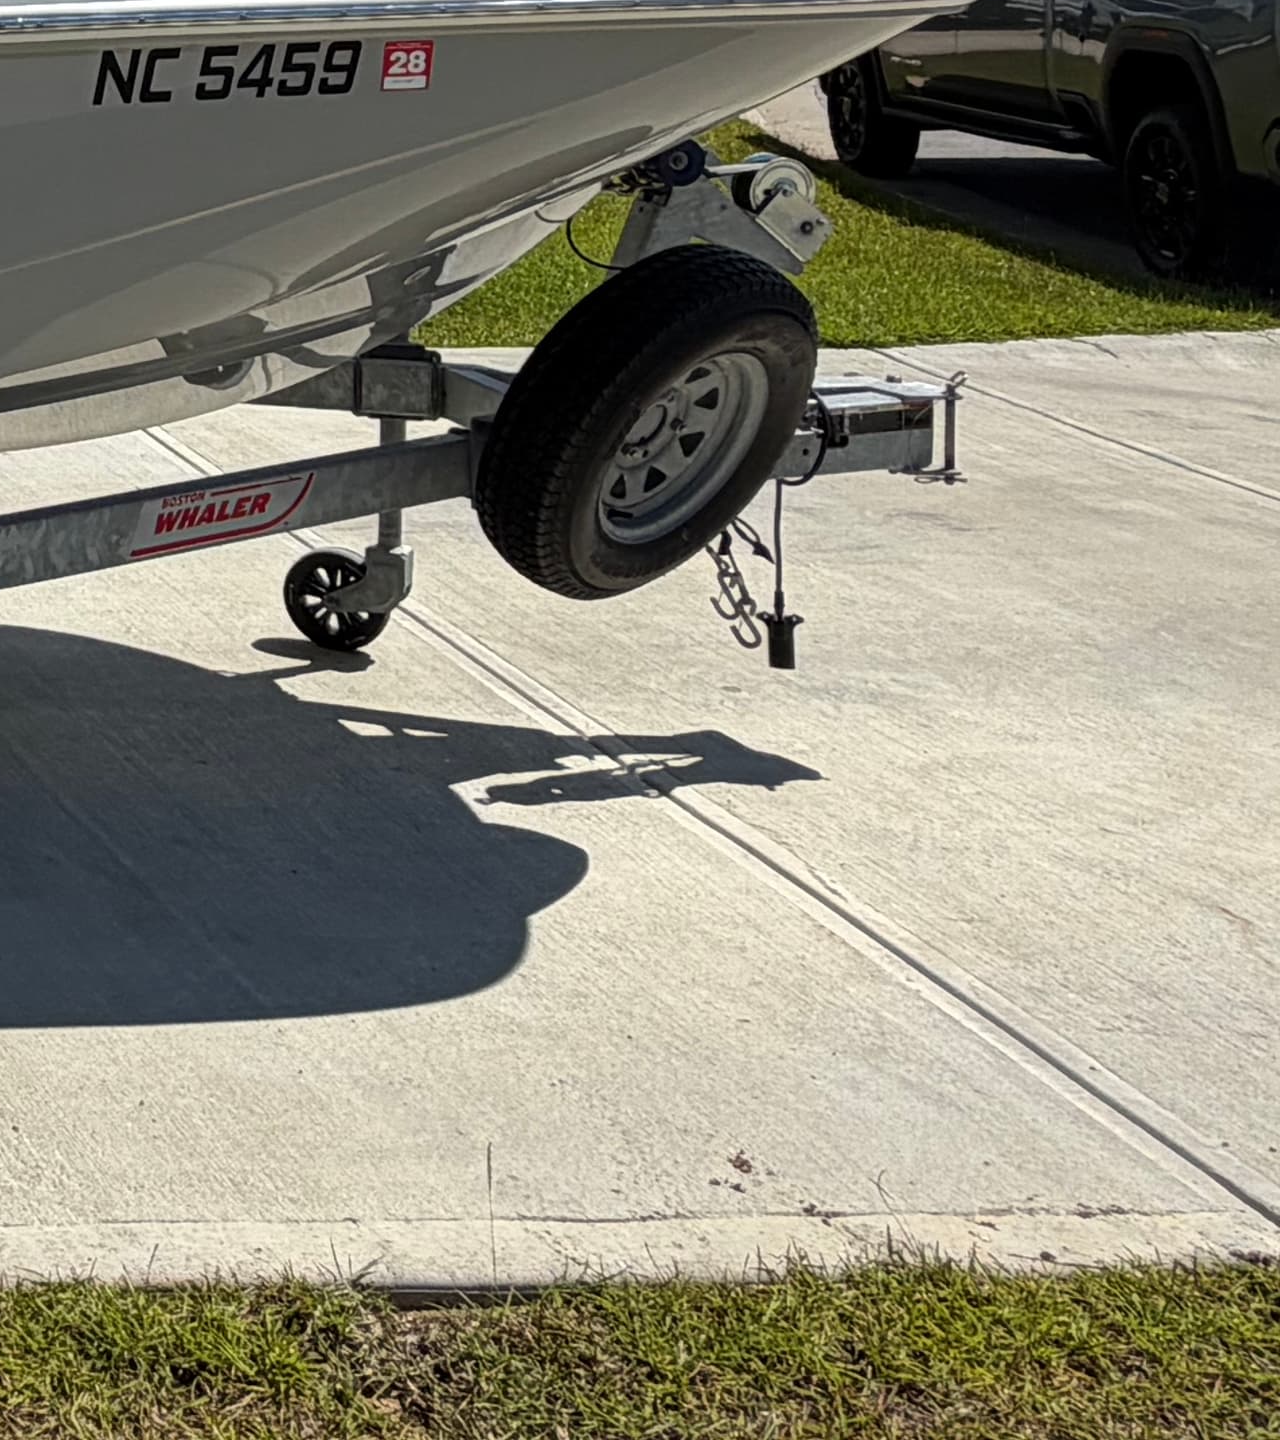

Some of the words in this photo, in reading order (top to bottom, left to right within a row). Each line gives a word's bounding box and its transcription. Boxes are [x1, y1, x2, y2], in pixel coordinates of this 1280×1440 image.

[92, 47, 182, 106] NC
[195, 40, 362, 100] 5459
[387, 50, 426, 74] 28
[154, 492, 272, 535] WHALER
[162, 491, 206, 509] BOSTON
